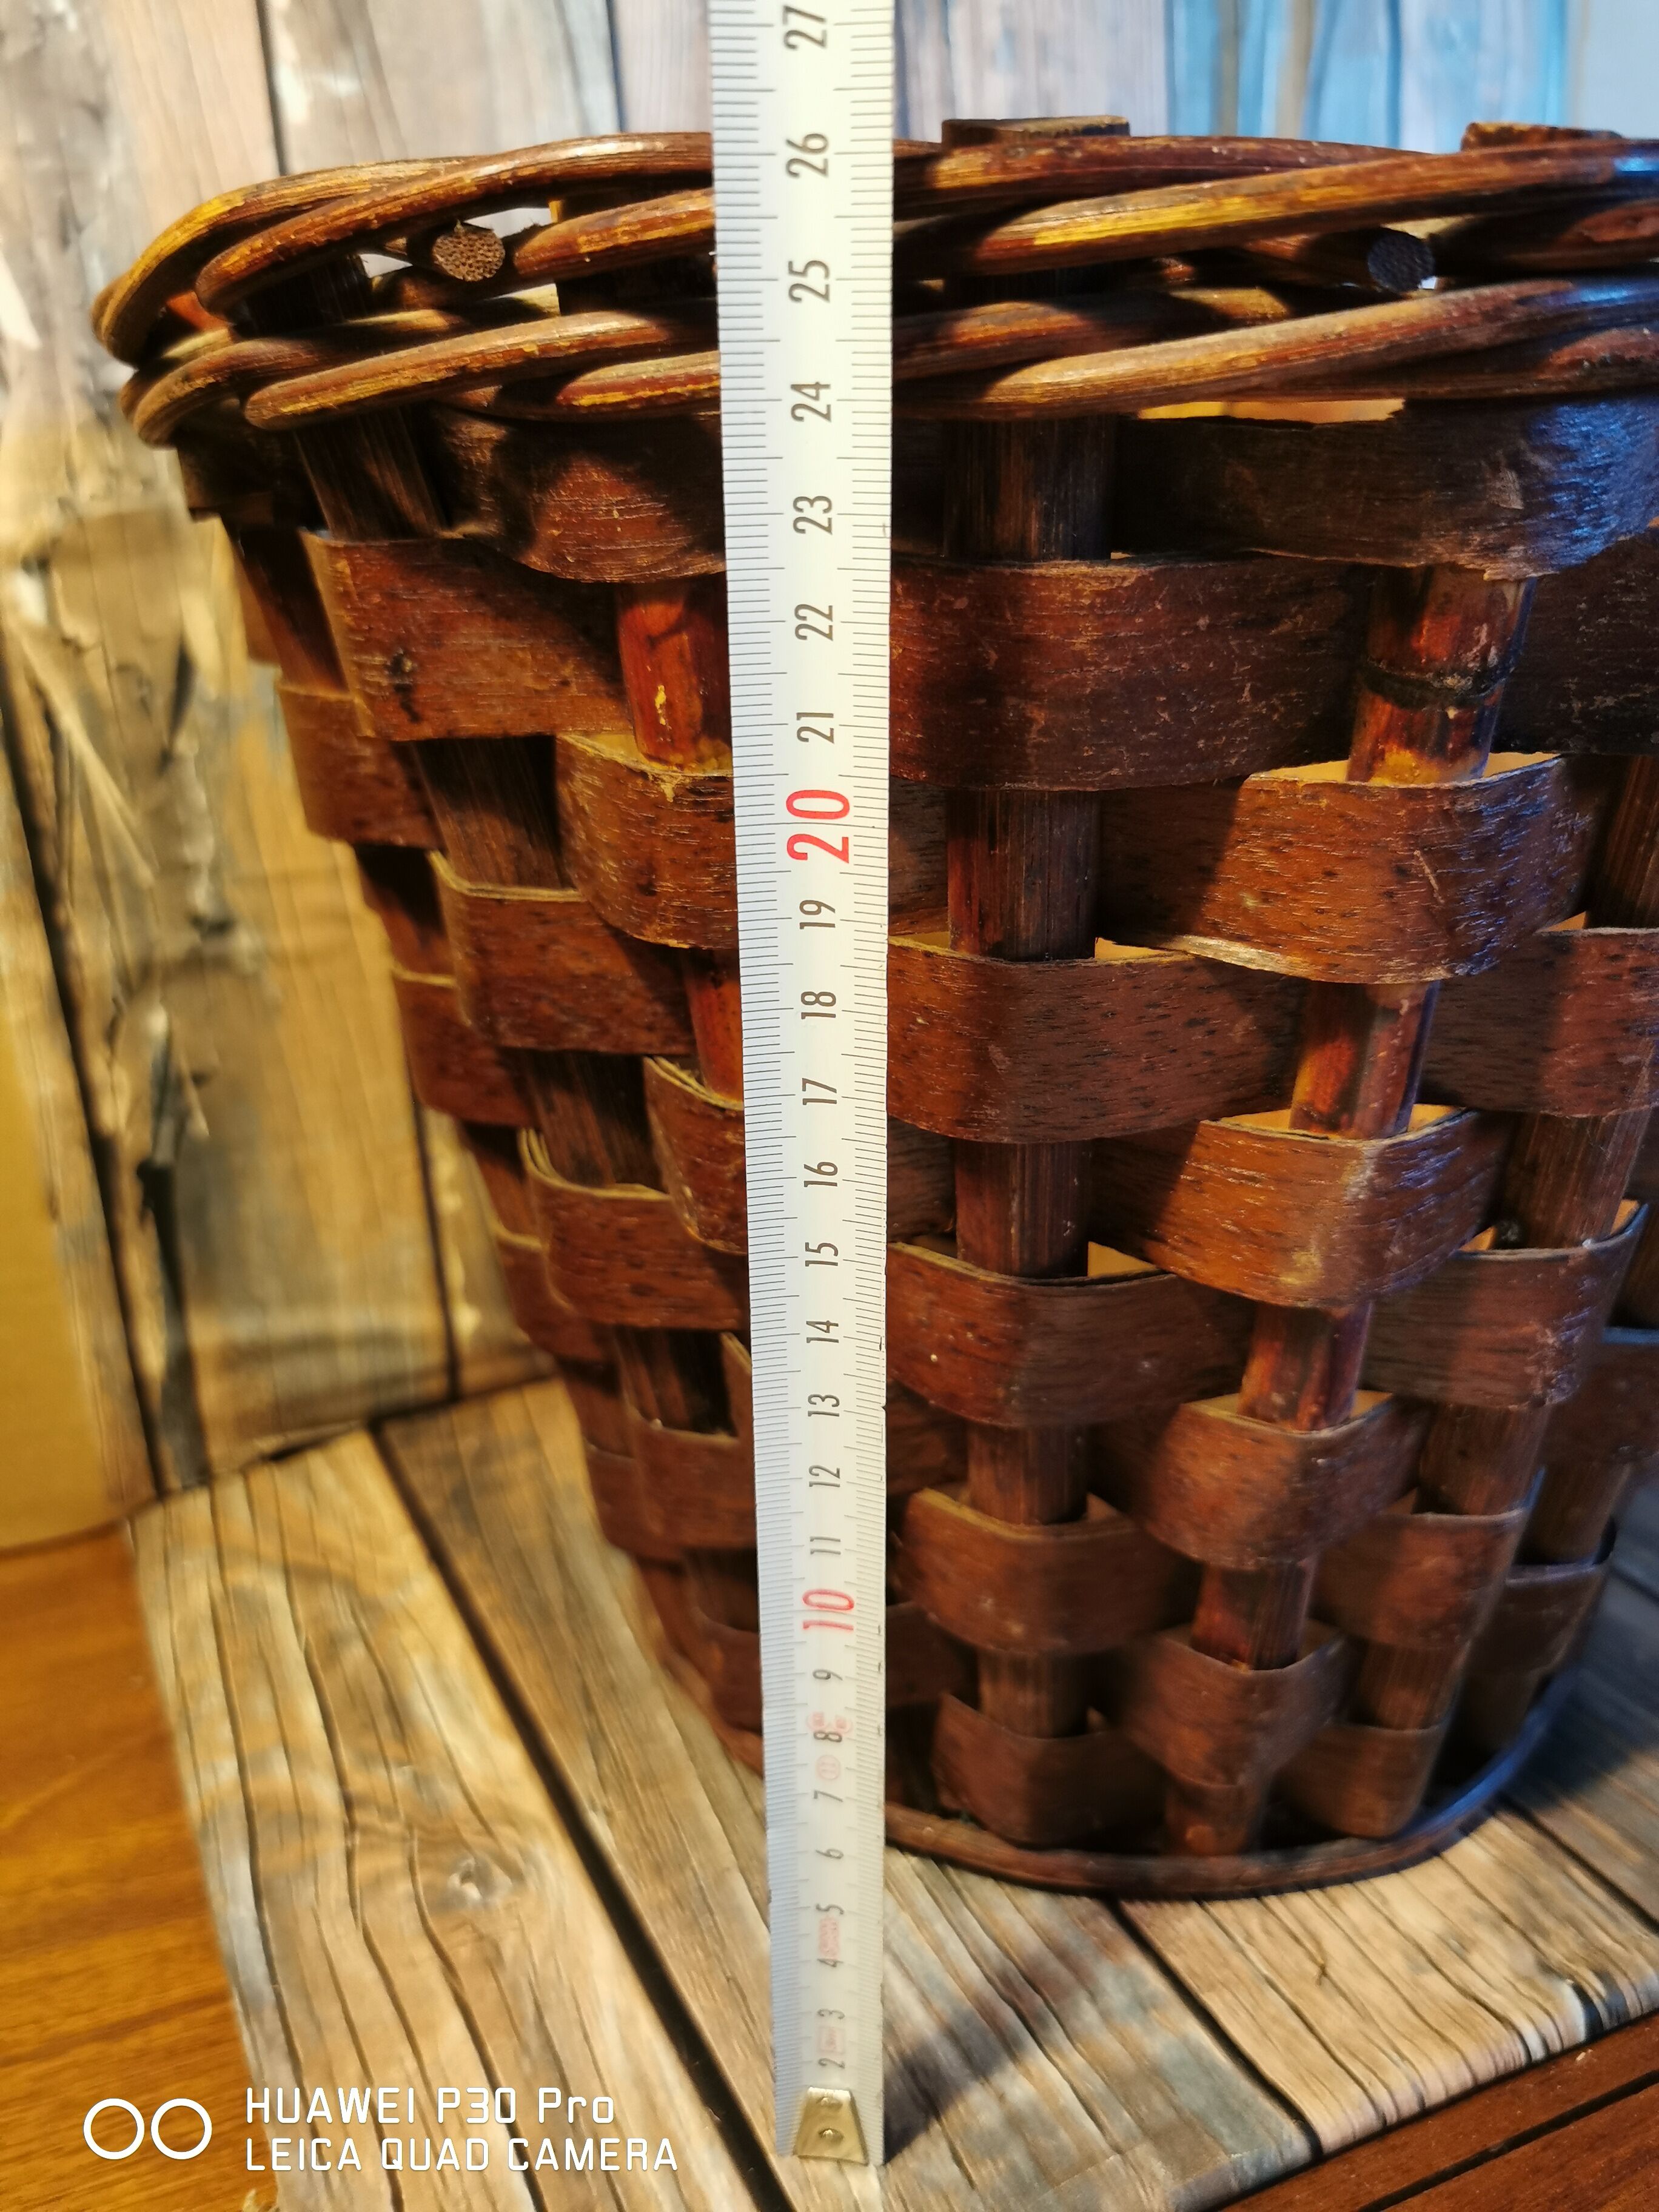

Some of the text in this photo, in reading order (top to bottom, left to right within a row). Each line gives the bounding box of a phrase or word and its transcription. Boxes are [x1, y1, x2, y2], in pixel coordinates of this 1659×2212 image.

[782, 5, 828, 50] 27
[786, 133, 829, 178] 26
[788, 260, 830, 303] 25
[790, 381, 832, 423] 24
[793, 495, 833, 535] 23
[794, 604, 834, 642] 22
[796, 712, 834, 744] 21
[786, 789, 850, 863] 20
[799, 900, 836, 930] 19
[800, 991, 836, 1020] 18
[802, 1078, 837, 1105] 17
[803, 1162, 838, 1188] 16
[805, 1242, 839, 1267] 15
[806, 1320, 839, 1344] 14
[808, 1394, 840, 1417] 13
[809, 1464, 840, 1487] 12
[810, 1537, 841, 1555] 11
[802, 1589, 854, 1631] 10
[813, 1669, 843, 1681] 9
[813, 1730, 843, 1743] 8
[813, 1790, 843, 1802] 7
[816, 1848, 844, 1860] 6
[815, 1903, 844, 1915] 5
[816, 1958, 844, 1968] 4
[817, 2008, 845, 2020] 3
[818, 2058, 846, 2069] 2
